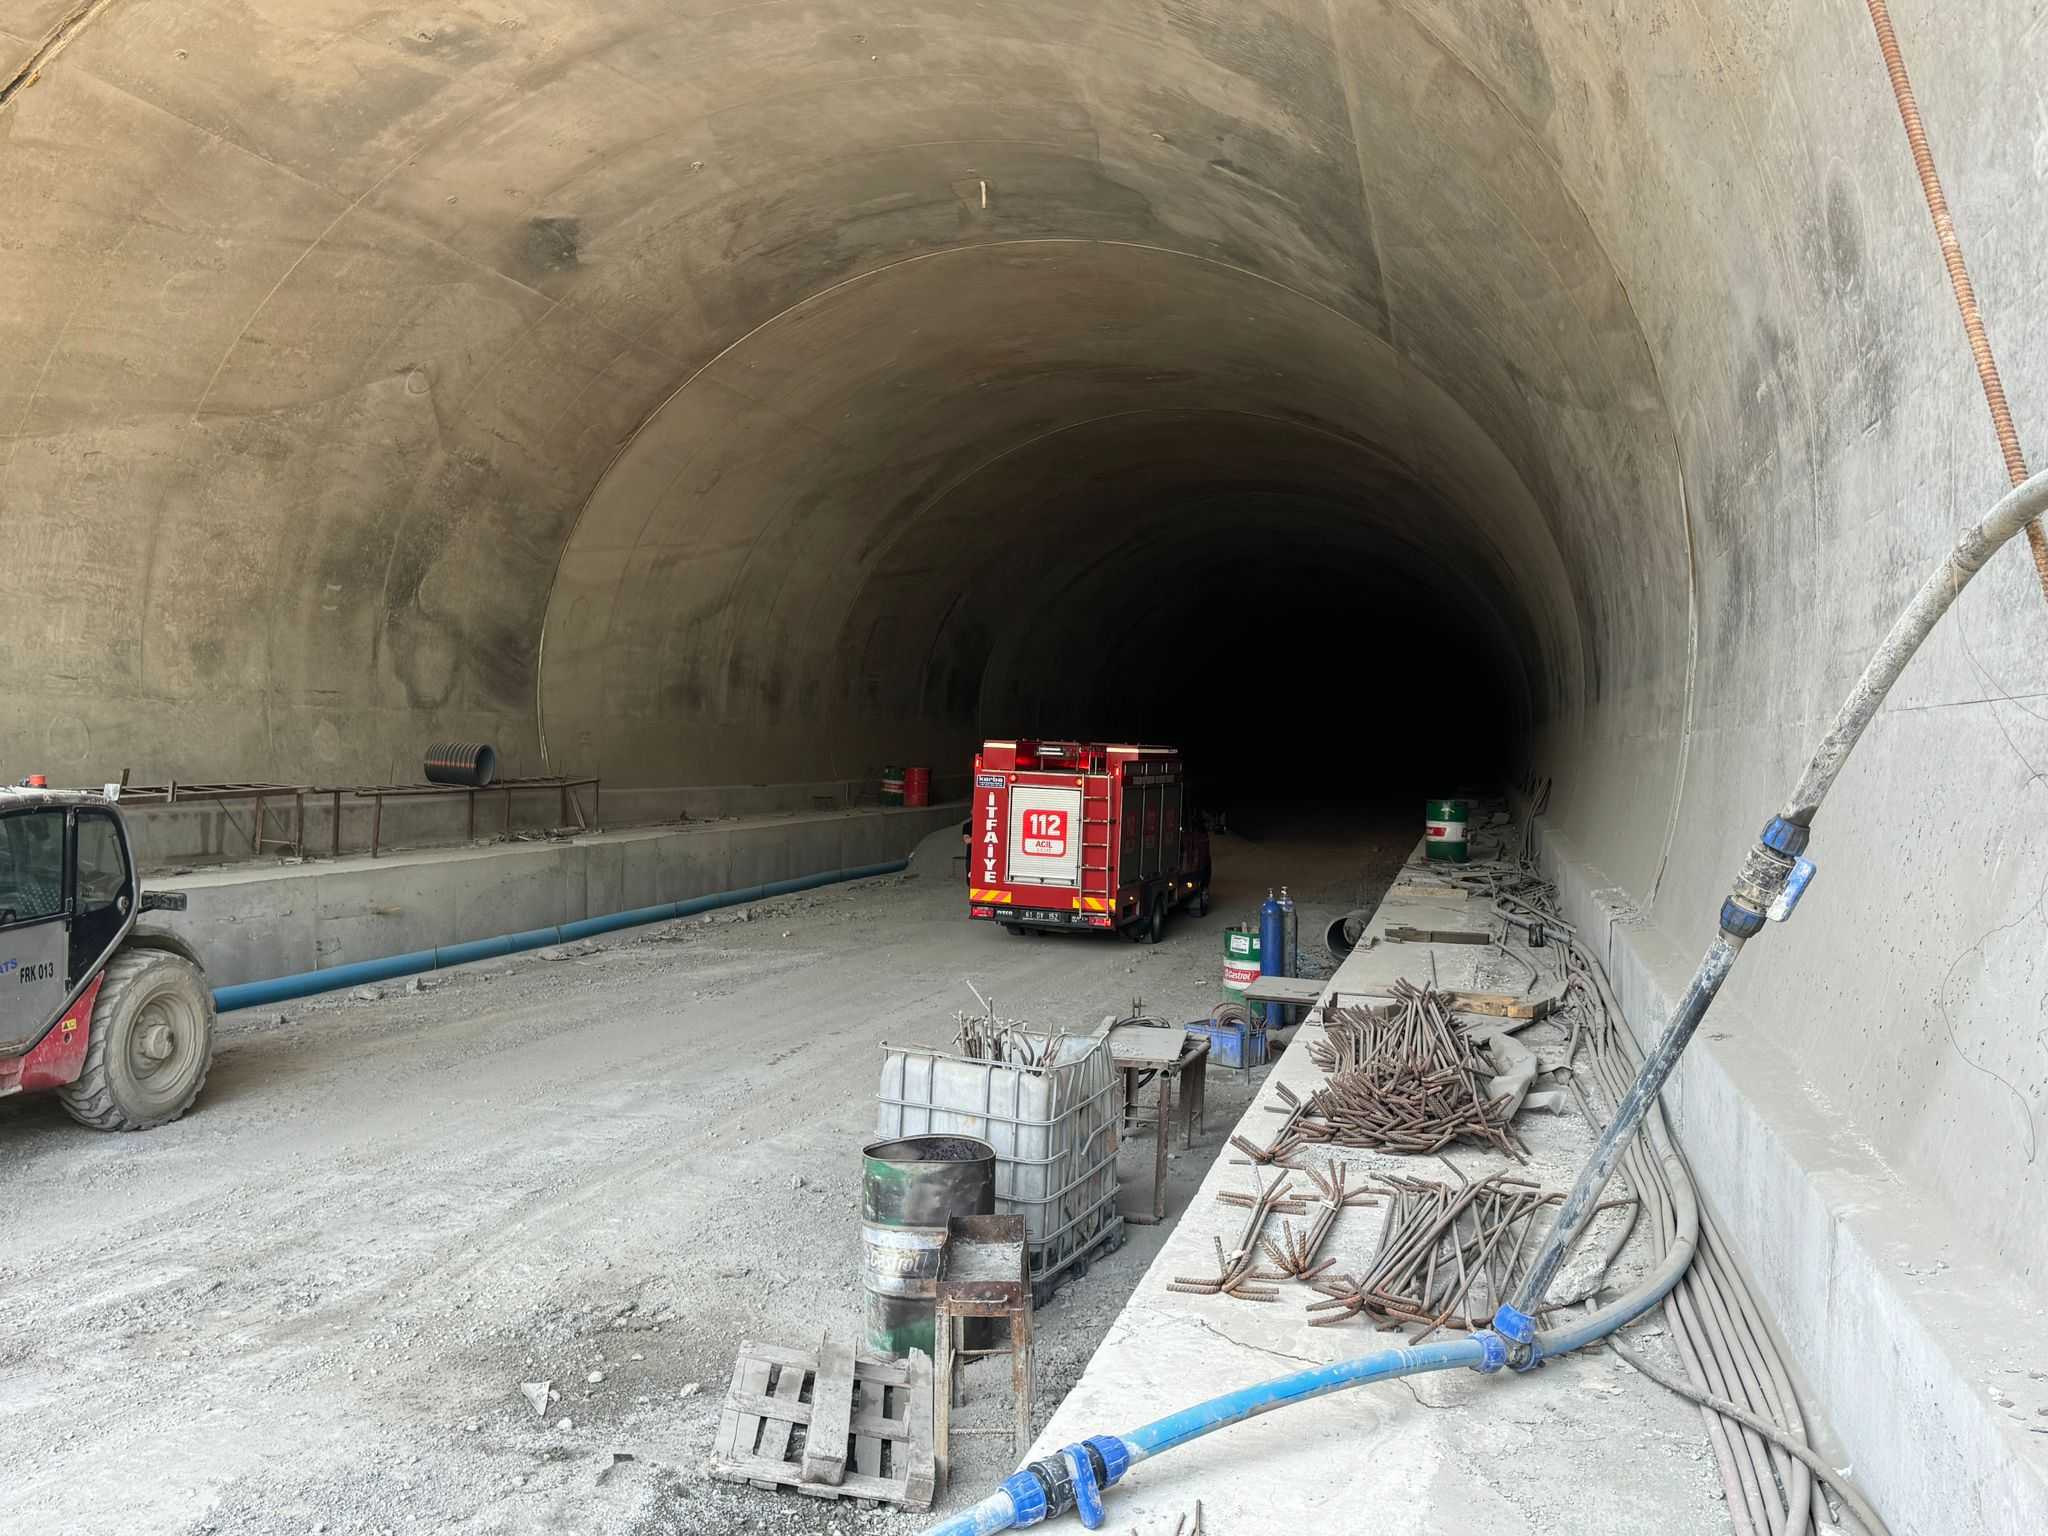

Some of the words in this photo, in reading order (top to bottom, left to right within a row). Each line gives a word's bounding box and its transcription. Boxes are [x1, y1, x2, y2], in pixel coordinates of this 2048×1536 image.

[1030, 813, 1060, 836] 112
[20, 965, 36, 984] FRK
[38, 962, 54, 980] 013
